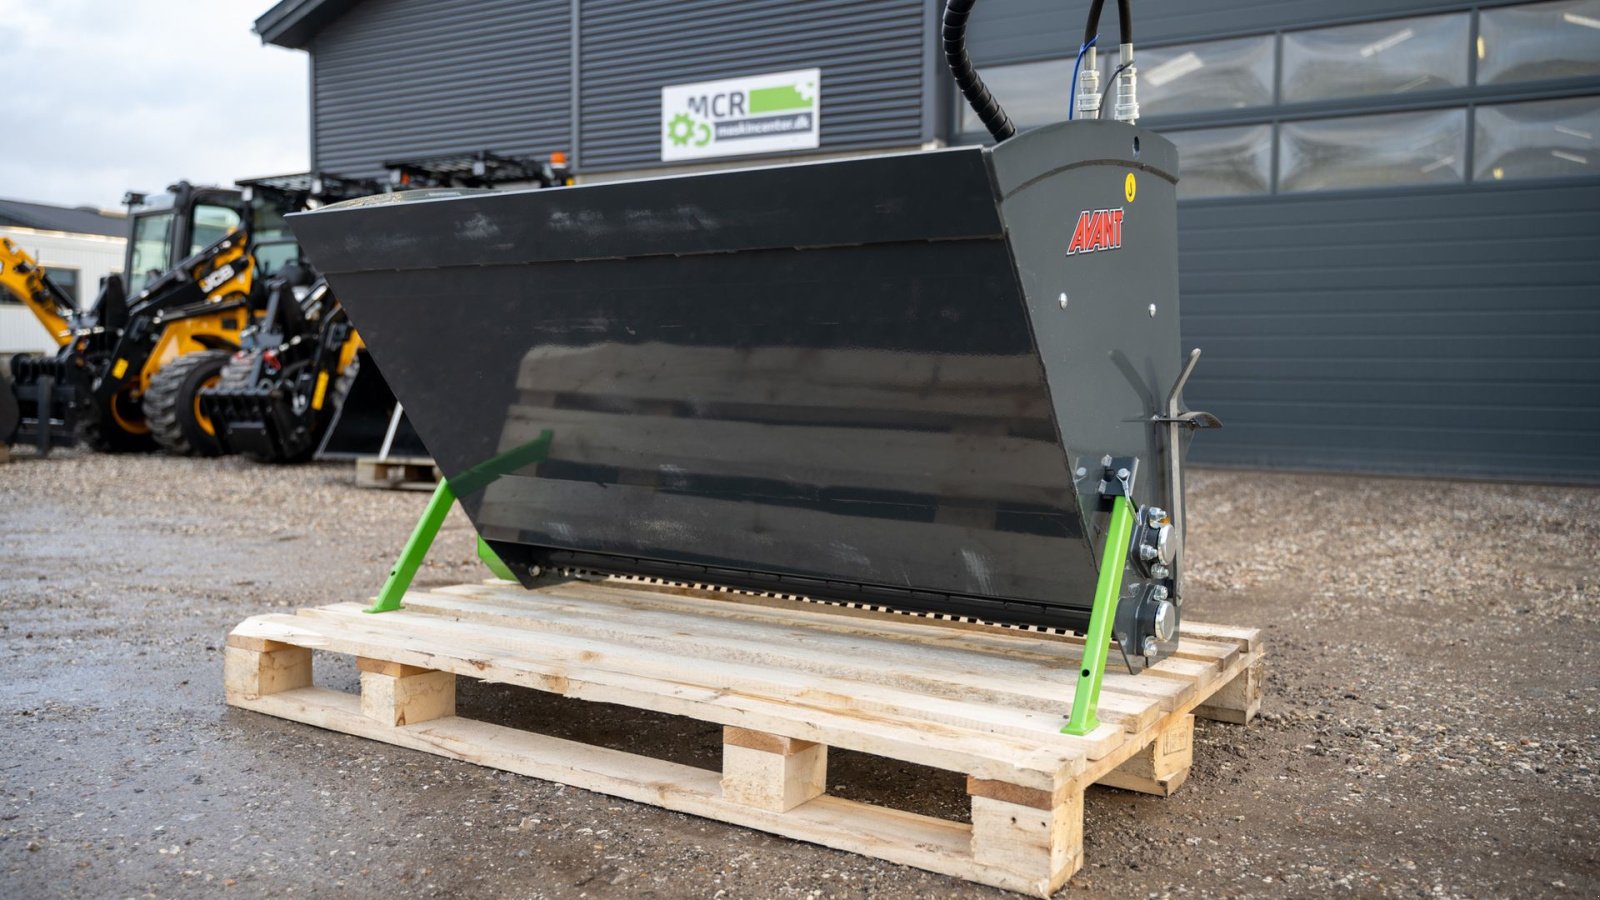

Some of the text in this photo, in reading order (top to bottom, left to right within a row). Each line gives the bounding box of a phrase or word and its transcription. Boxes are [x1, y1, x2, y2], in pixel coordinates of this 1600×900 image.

[689, 92, 745, 117] MCR
[719, 115, 809, 137] maskincenter.dk
[1066, 209, 1124, 254] AVANT
[202, 264, 235, 293] JCB
